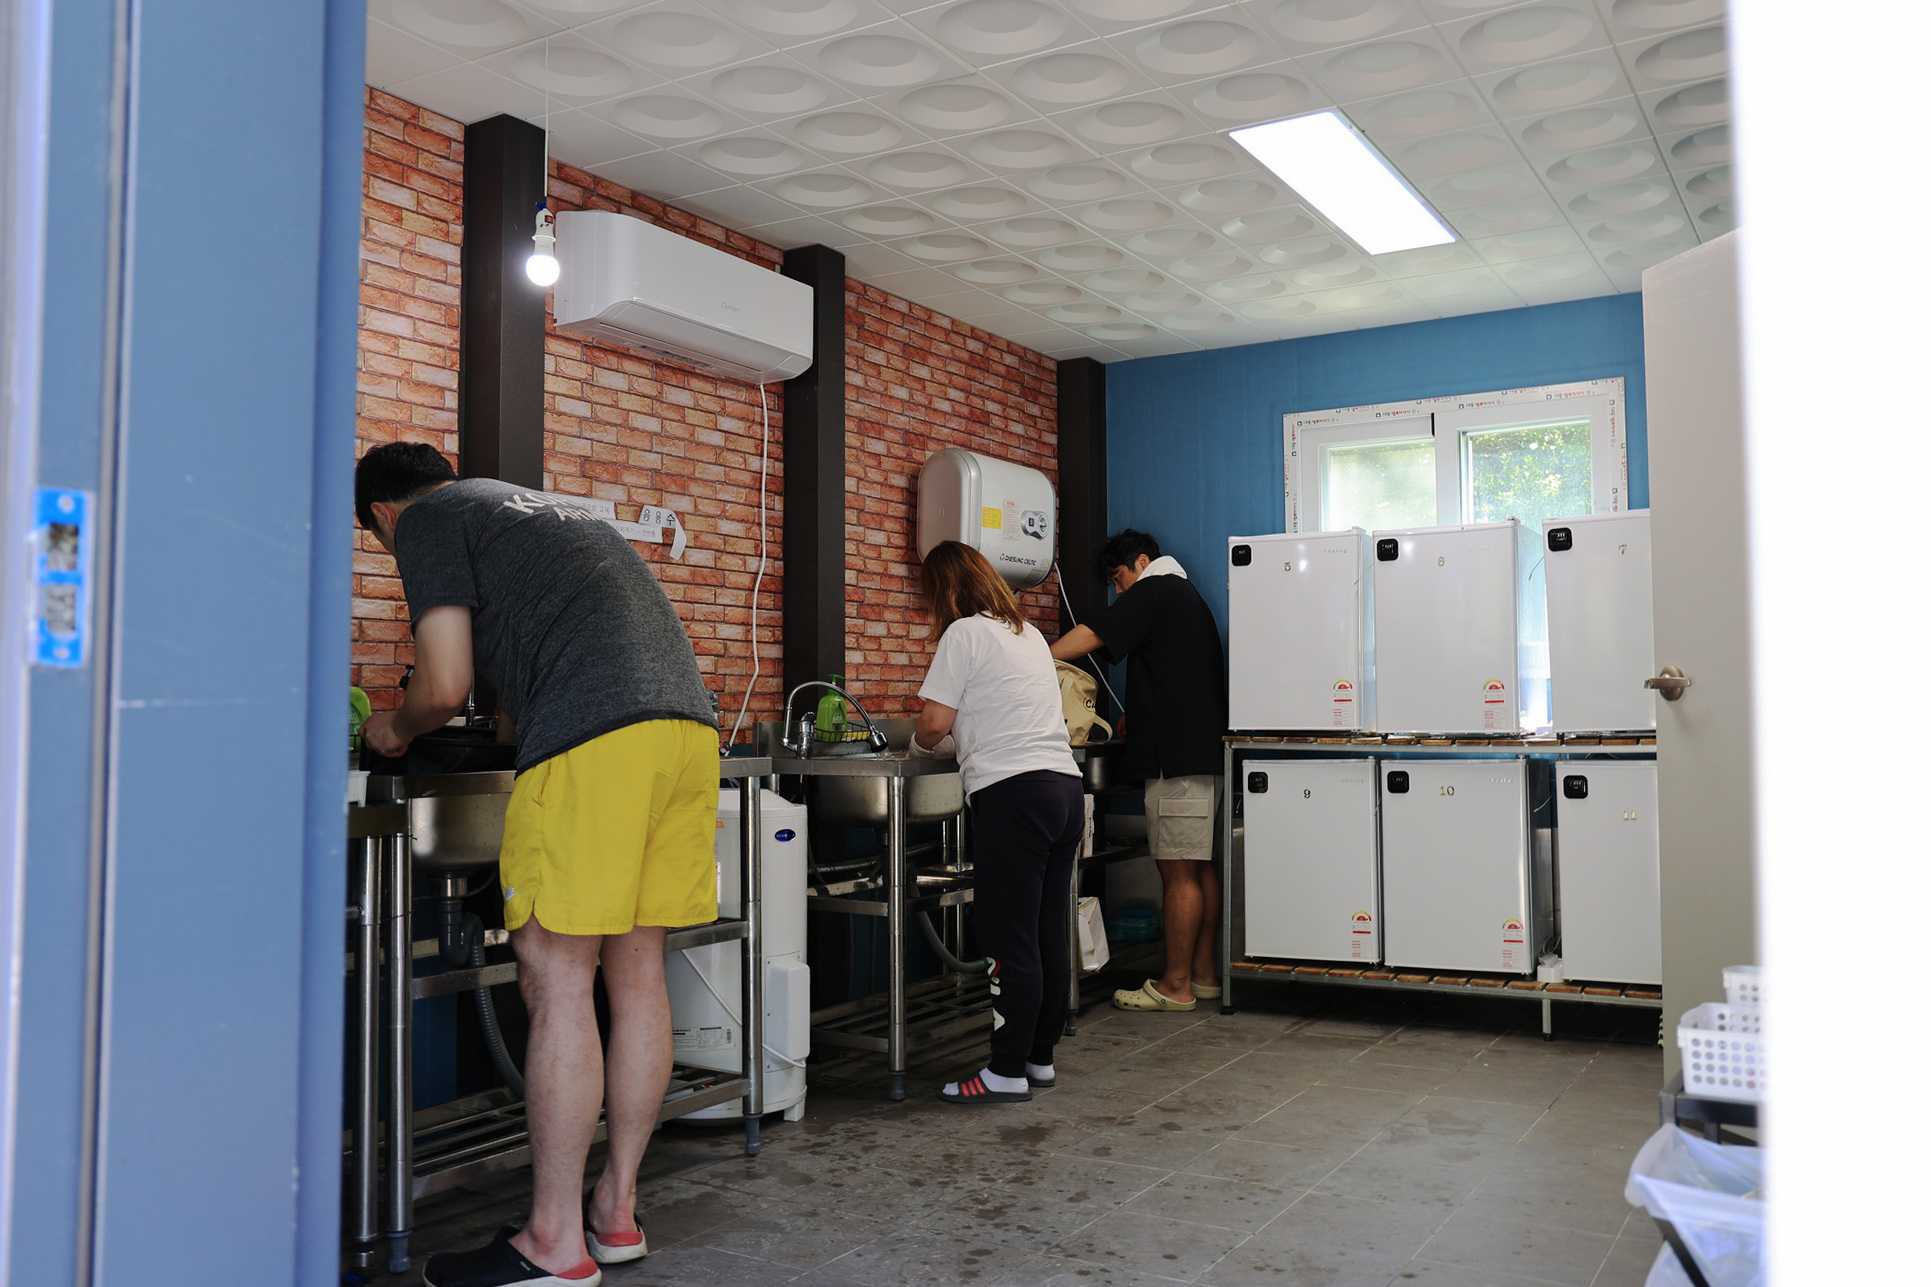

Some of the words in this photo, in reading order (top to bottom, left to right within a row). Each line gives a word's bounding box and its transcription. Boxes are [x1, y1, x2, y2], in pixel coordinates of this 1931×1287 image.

[1618, 543, 1628, 555] 7
[1437, 556, 1446, 567] 6
[1303, 788, 1311, 799] 9
[1440, 785, 1455, 796] 10
[1623, 809, 1637, 821] 11
